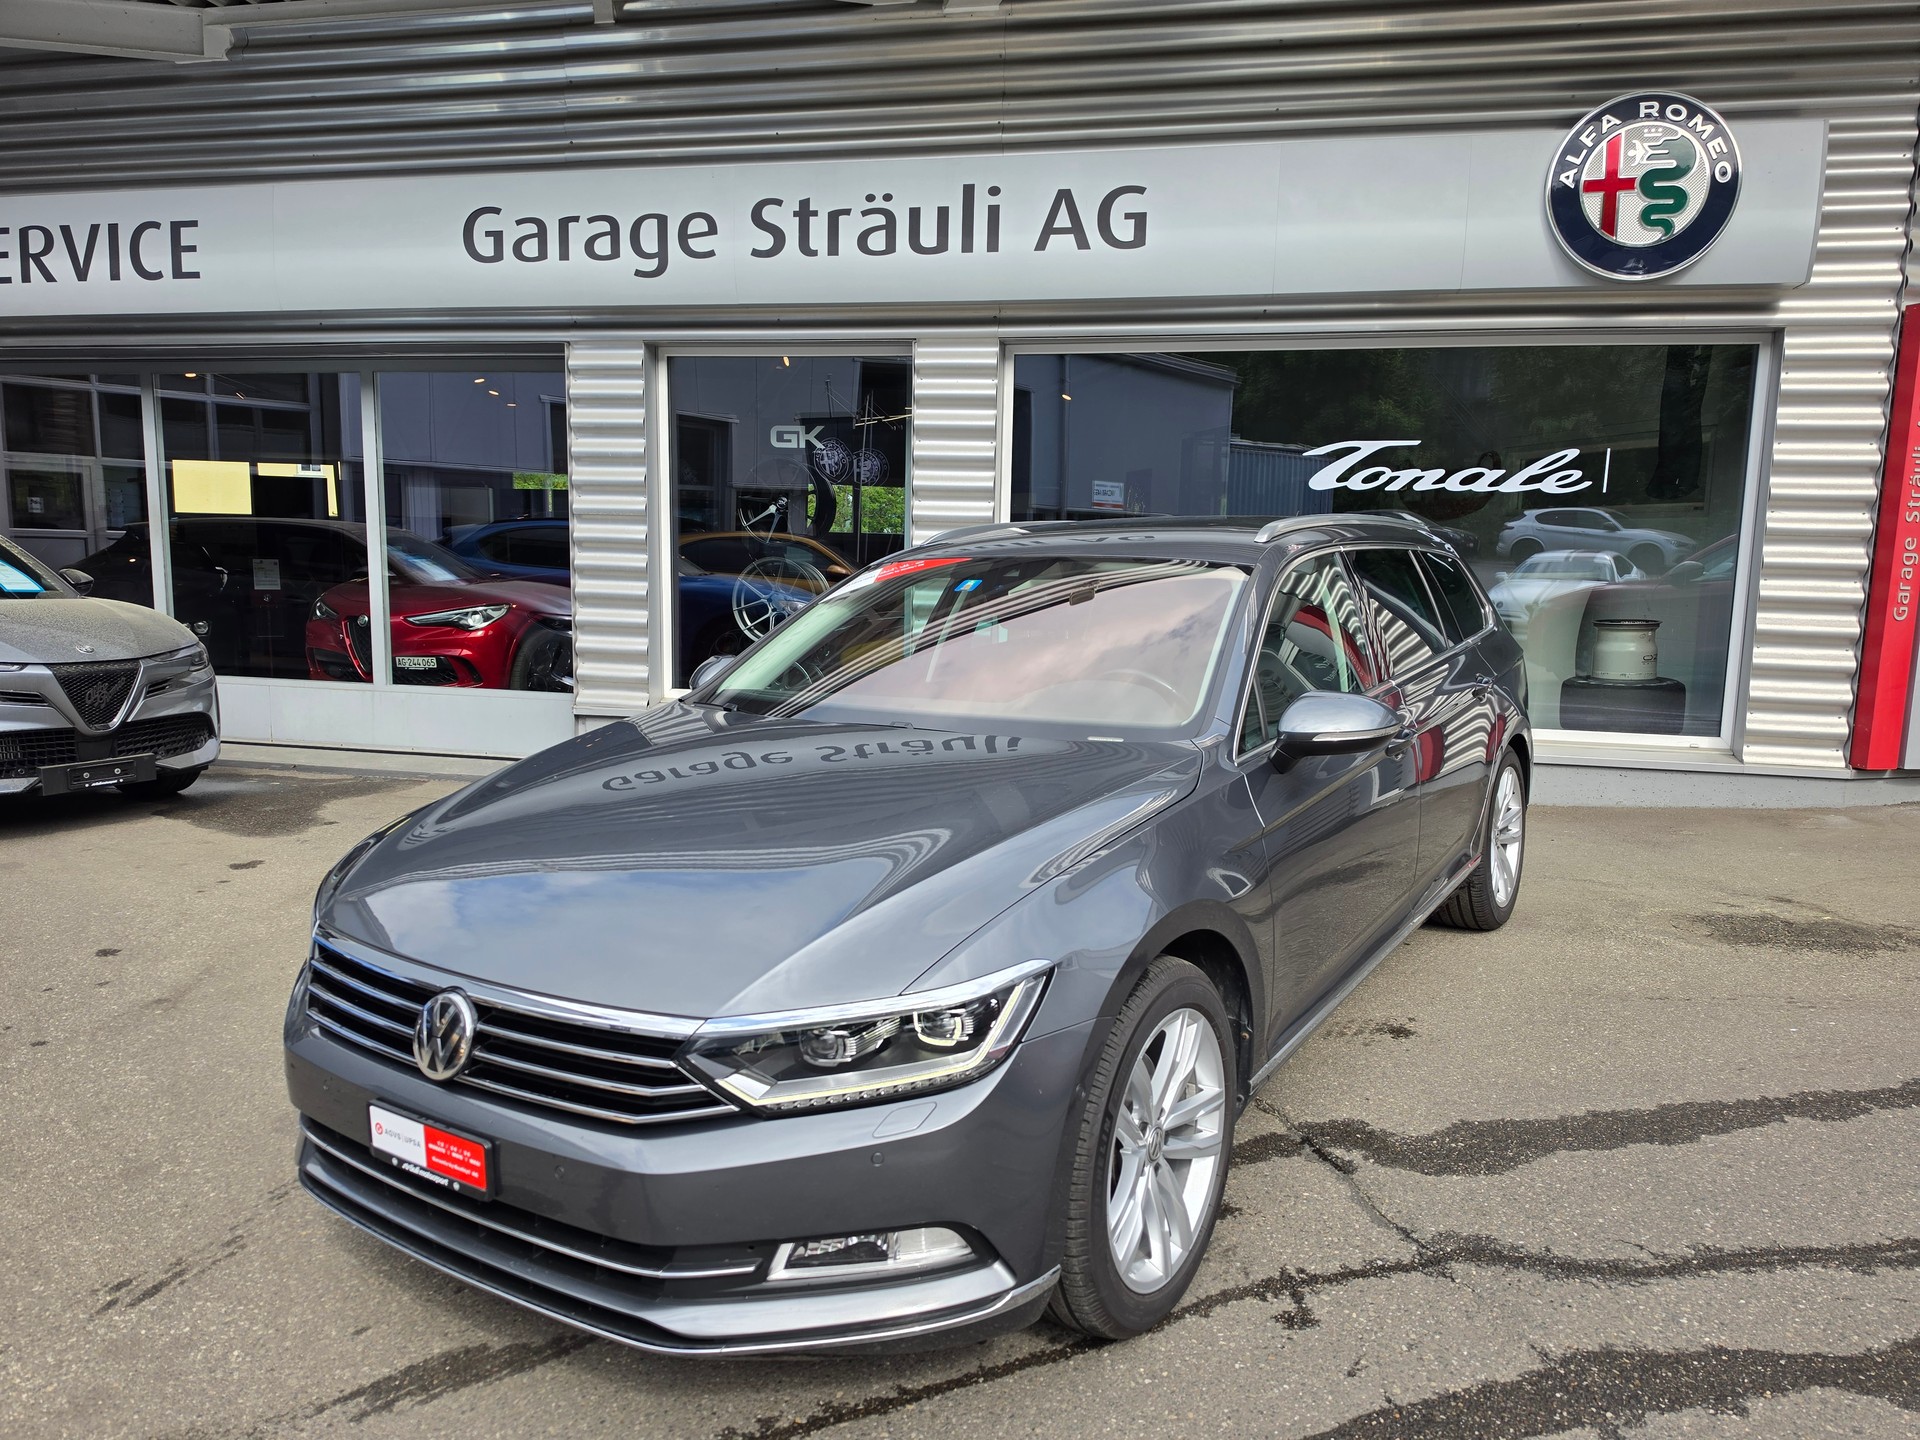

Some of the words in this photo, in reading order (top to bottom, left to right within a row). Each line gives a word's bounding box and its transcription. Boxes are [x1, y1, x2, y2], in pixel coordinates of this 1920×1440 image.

[1559, 113, 1622, 189] ALFA
[1639, 101, 1732, 184] ROMEO
[462, 206, 719, 279] Garage
[750, 183, 1002, 259] Sträuli
[1033, 184, 1148, 252] AG
[770, 425, 826, 449] GK
[1302, 440, 1592, 494] Tonale
[1893, 536, 1919, 622] Garage
